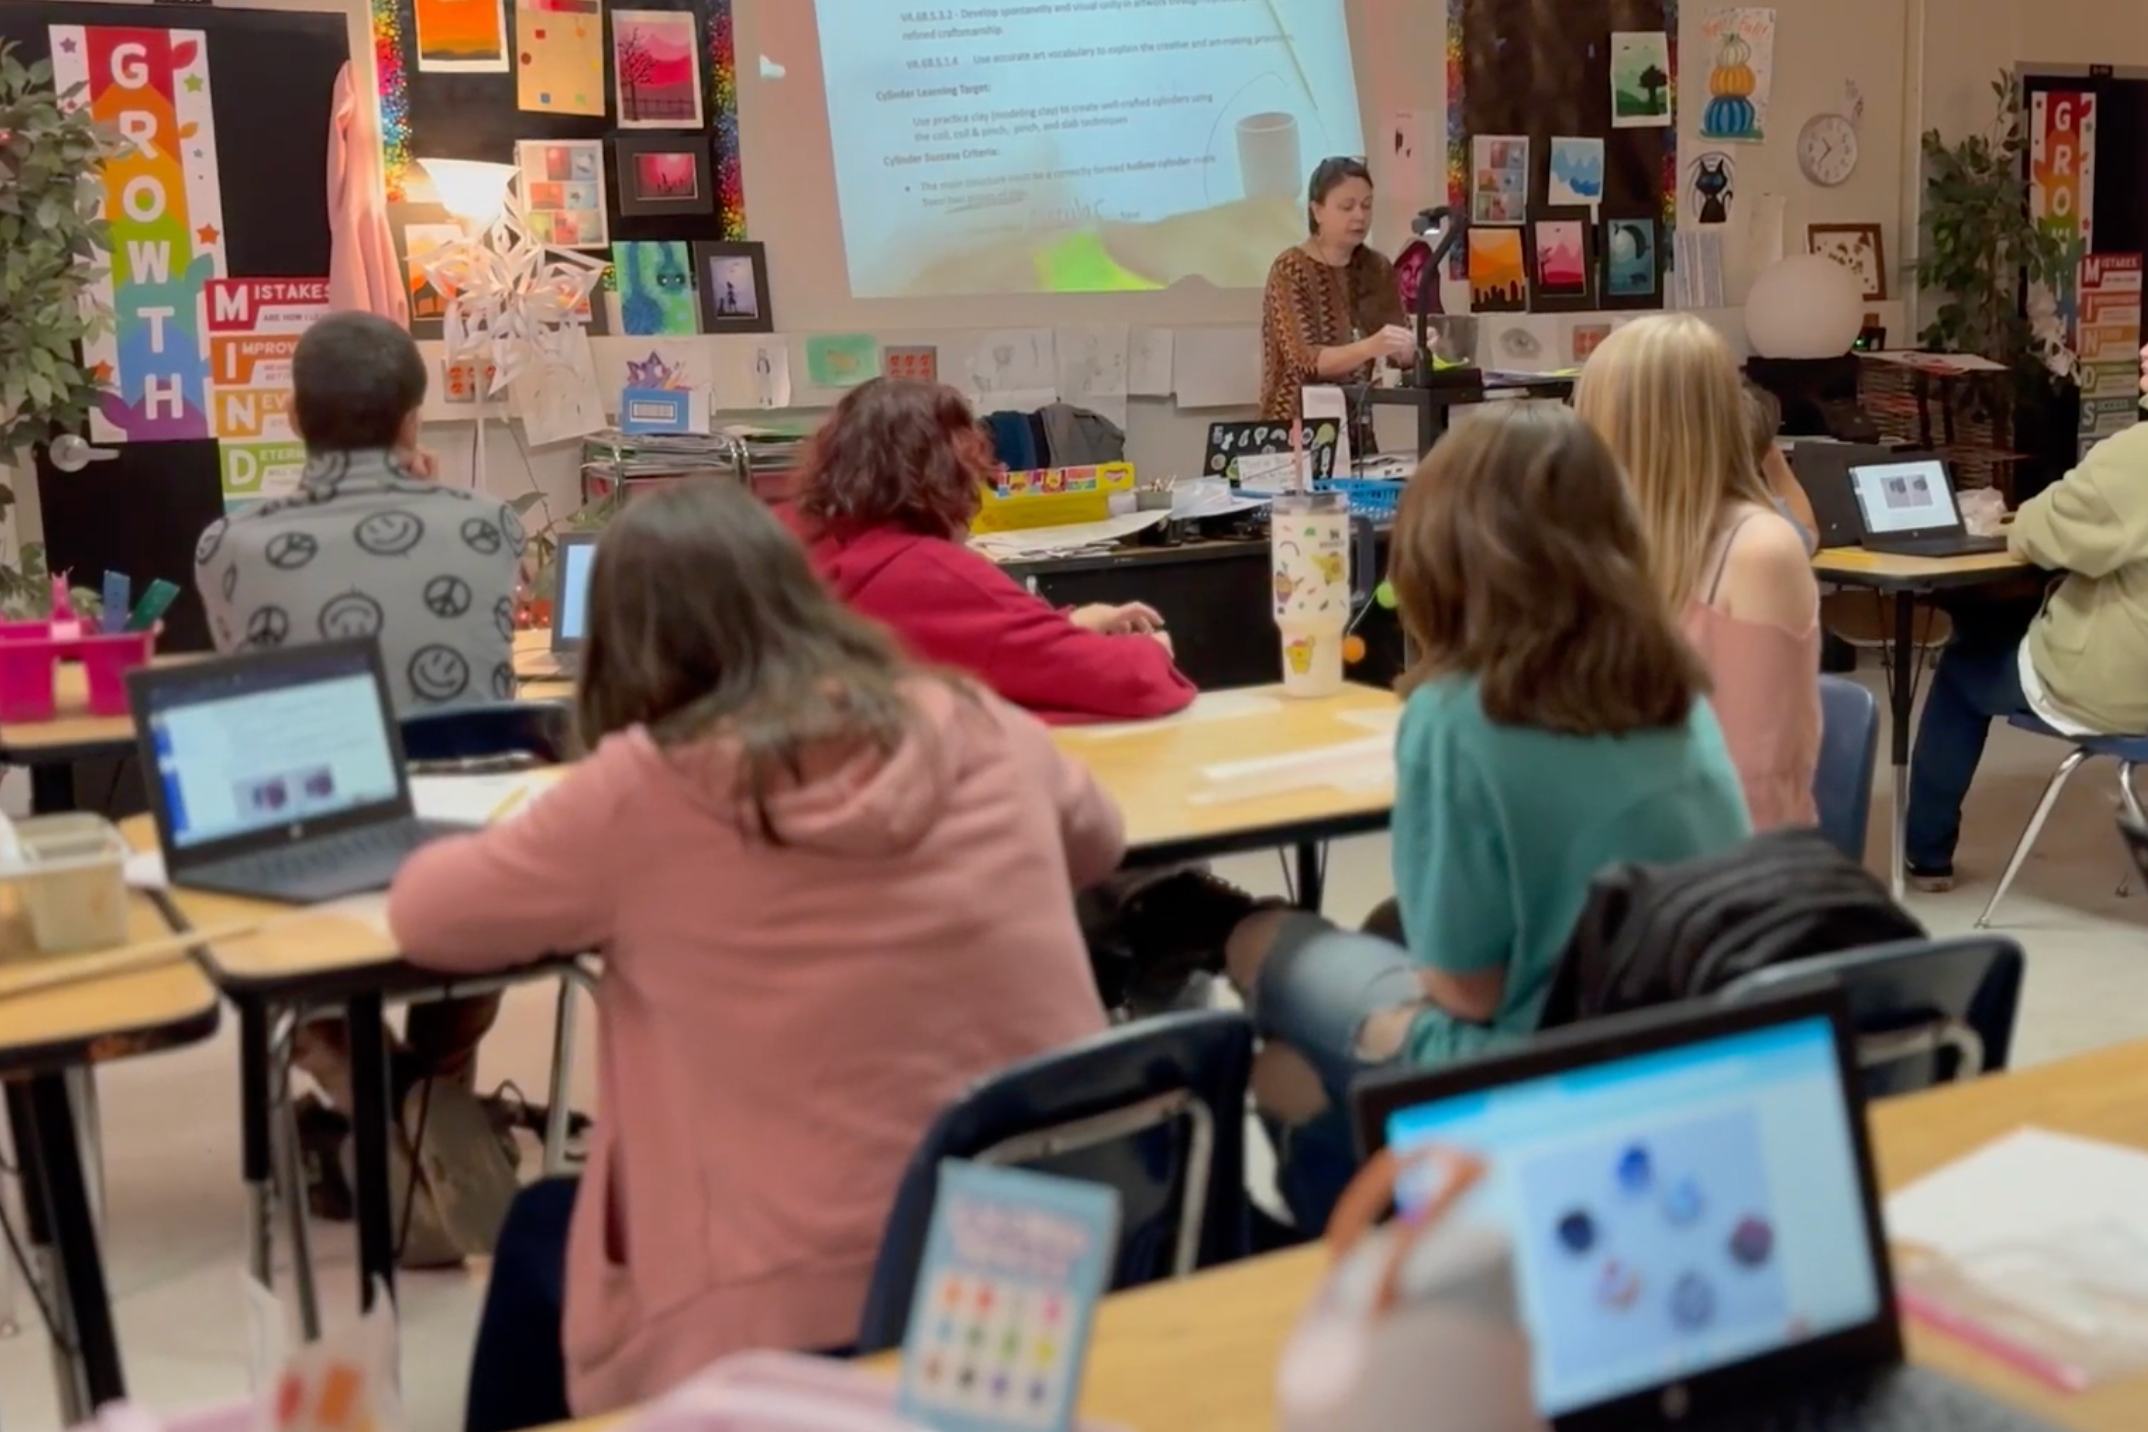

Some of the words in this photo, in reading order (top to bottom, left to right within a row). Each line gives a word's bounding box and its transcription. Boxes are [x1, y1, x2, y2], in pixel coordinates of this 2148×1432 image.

[960, 7, 998, 19] Develop
[1055, 2, 1071, 12] and
[1073, 1, 1097, 12] visual
[902, 29, 936, 40] refined
[973, 54, 991, 64] Use
[1033, 51, 1047, 60] art
[1048, 46, 1095, 58] vocabulary
[1097, 46, 1106, 54] to
[1108, 43, 1138, 55] explain
[1140, 42, 1154, 51] the
[1192, 38, 1207, 48] and
[876, 89, 915, 102] Cylinder
[917, 85, 958, 98] Learning
[959, 82, 992, 96] Target:
[913, 116, 930, 126] Use
[971, 112, 989, 123] clay
[1060, 103, 1070, 113] to
[1072, 102, 1099, 113] create
[1152, 94, 1189, 108] cylinders
[1191, 93, 1213, 104] using
[914, 131, 930, 142] the
[954, 128, 970, 139] coil
[972, 127, 980, 137] &
[1043, 121, 1060, 131] and
[1061, 118, 1079, 129] slab
[883, 154, 922, 168] Cylinder
[924, 151, 961, 164] Success
[962, 148, 1000, 161] Criteria:
[920, 181, 938, 191] The
[1126, 159, 1156, 172] hollow
[1158, 156, 1191, 169] cylinder
[110, 43, 182, 420] GROWTH
